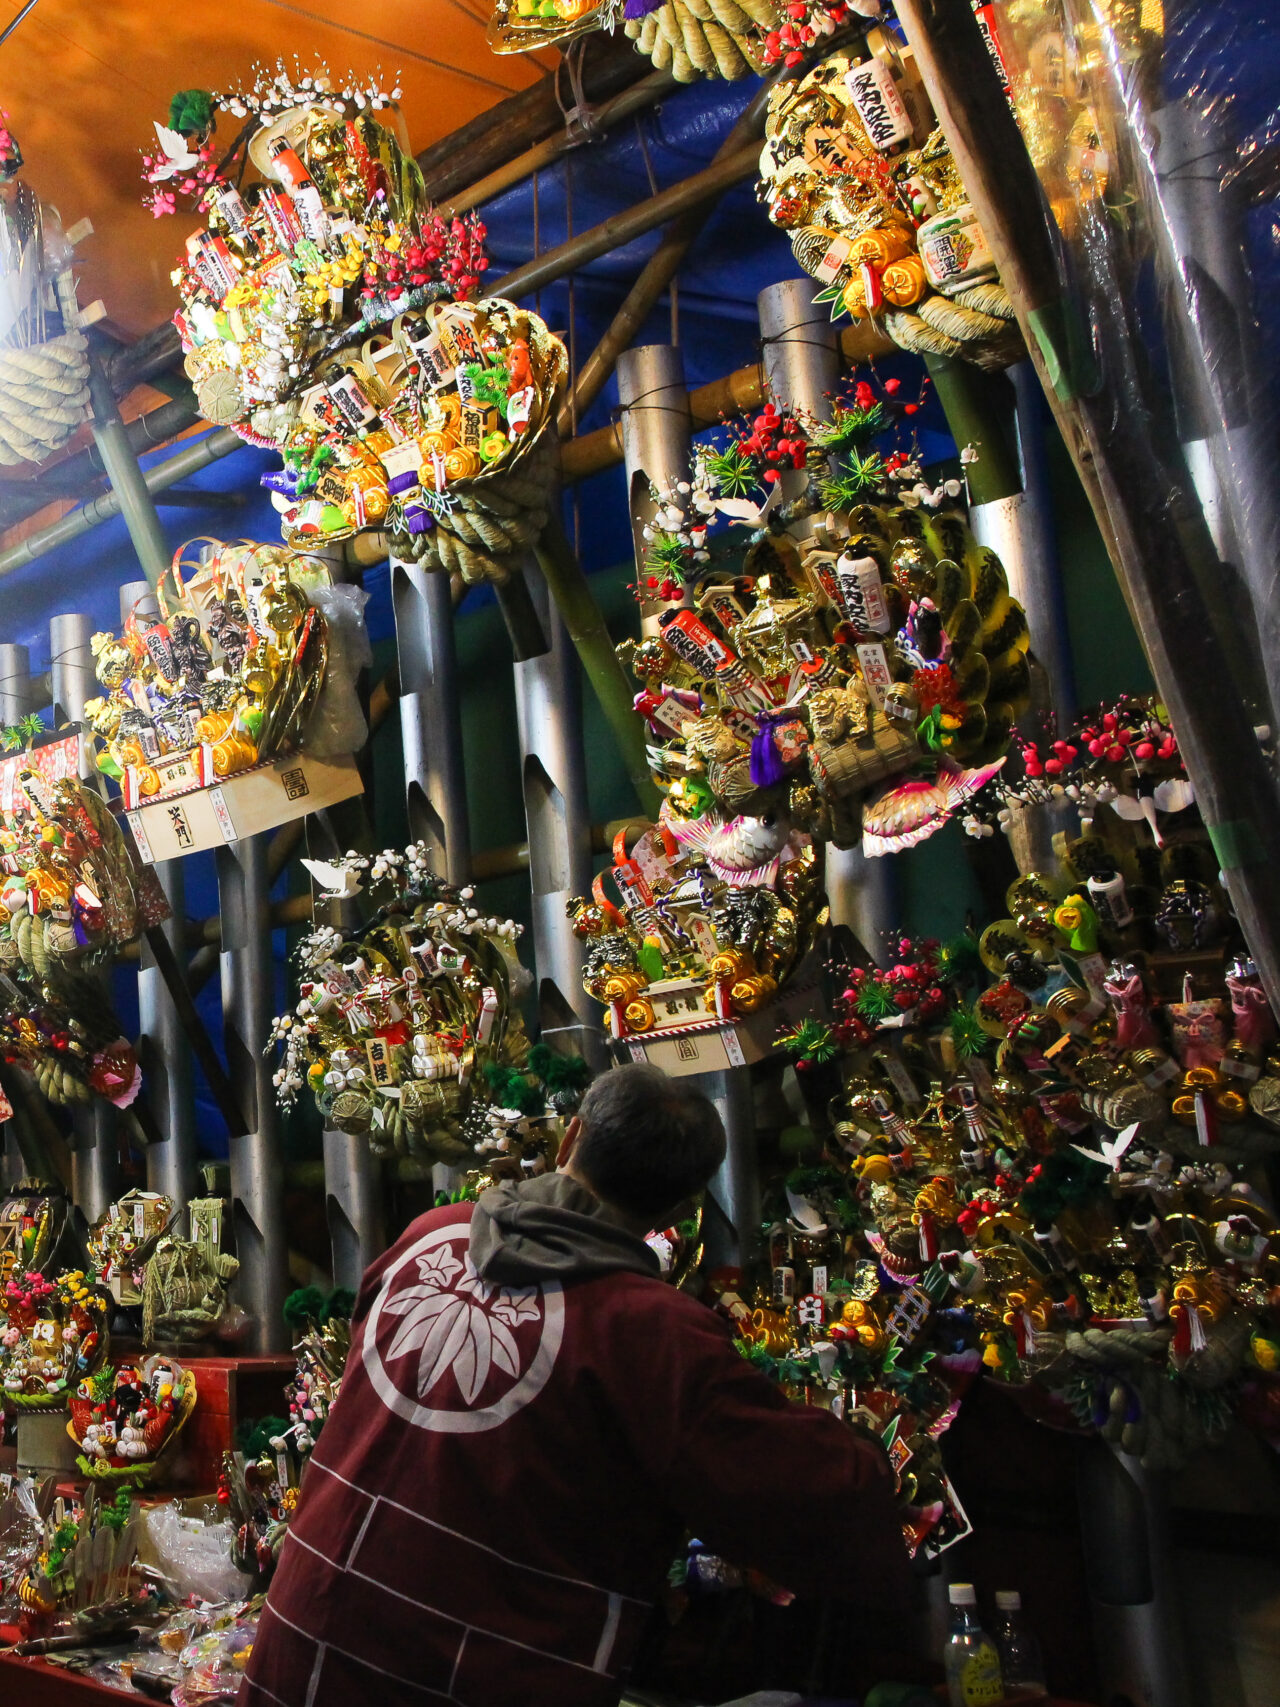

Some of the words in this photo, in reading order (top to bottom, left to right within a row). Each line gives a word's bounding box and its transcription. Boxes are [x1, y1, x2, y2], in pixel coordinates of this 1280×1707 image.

[851, 72, 896, 143] 家内安全
[933, 236, 962, 279] 開運
[840, 572, 871, 633] 家内安全
[170, 807, 189, 846] 笑門
[371, 1043, 388, 1083] 吉祥
